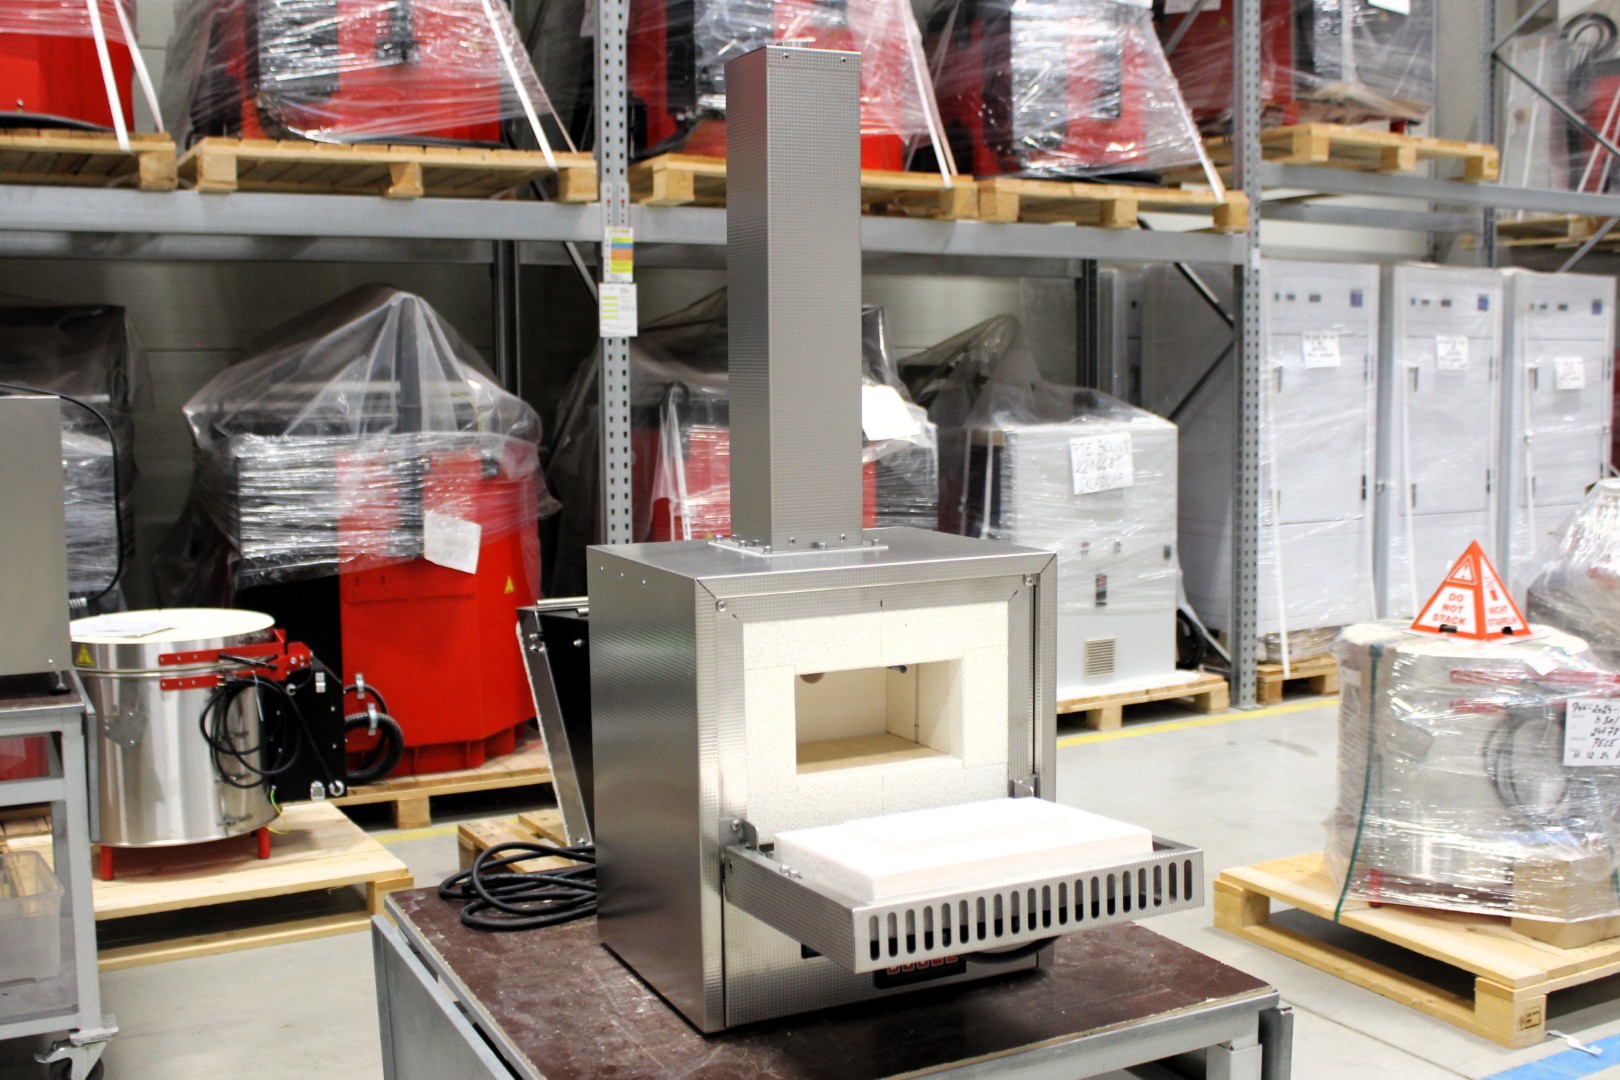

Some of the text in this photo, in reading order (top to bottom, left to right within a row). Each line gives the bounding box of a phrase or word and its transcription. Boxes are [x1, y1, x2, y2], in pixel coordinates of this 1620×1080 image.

[1448, 593, 1464, 602] DO
[1441, 604, 1464, 613] NOT
[1432, 614, 1466, 625] STACK
